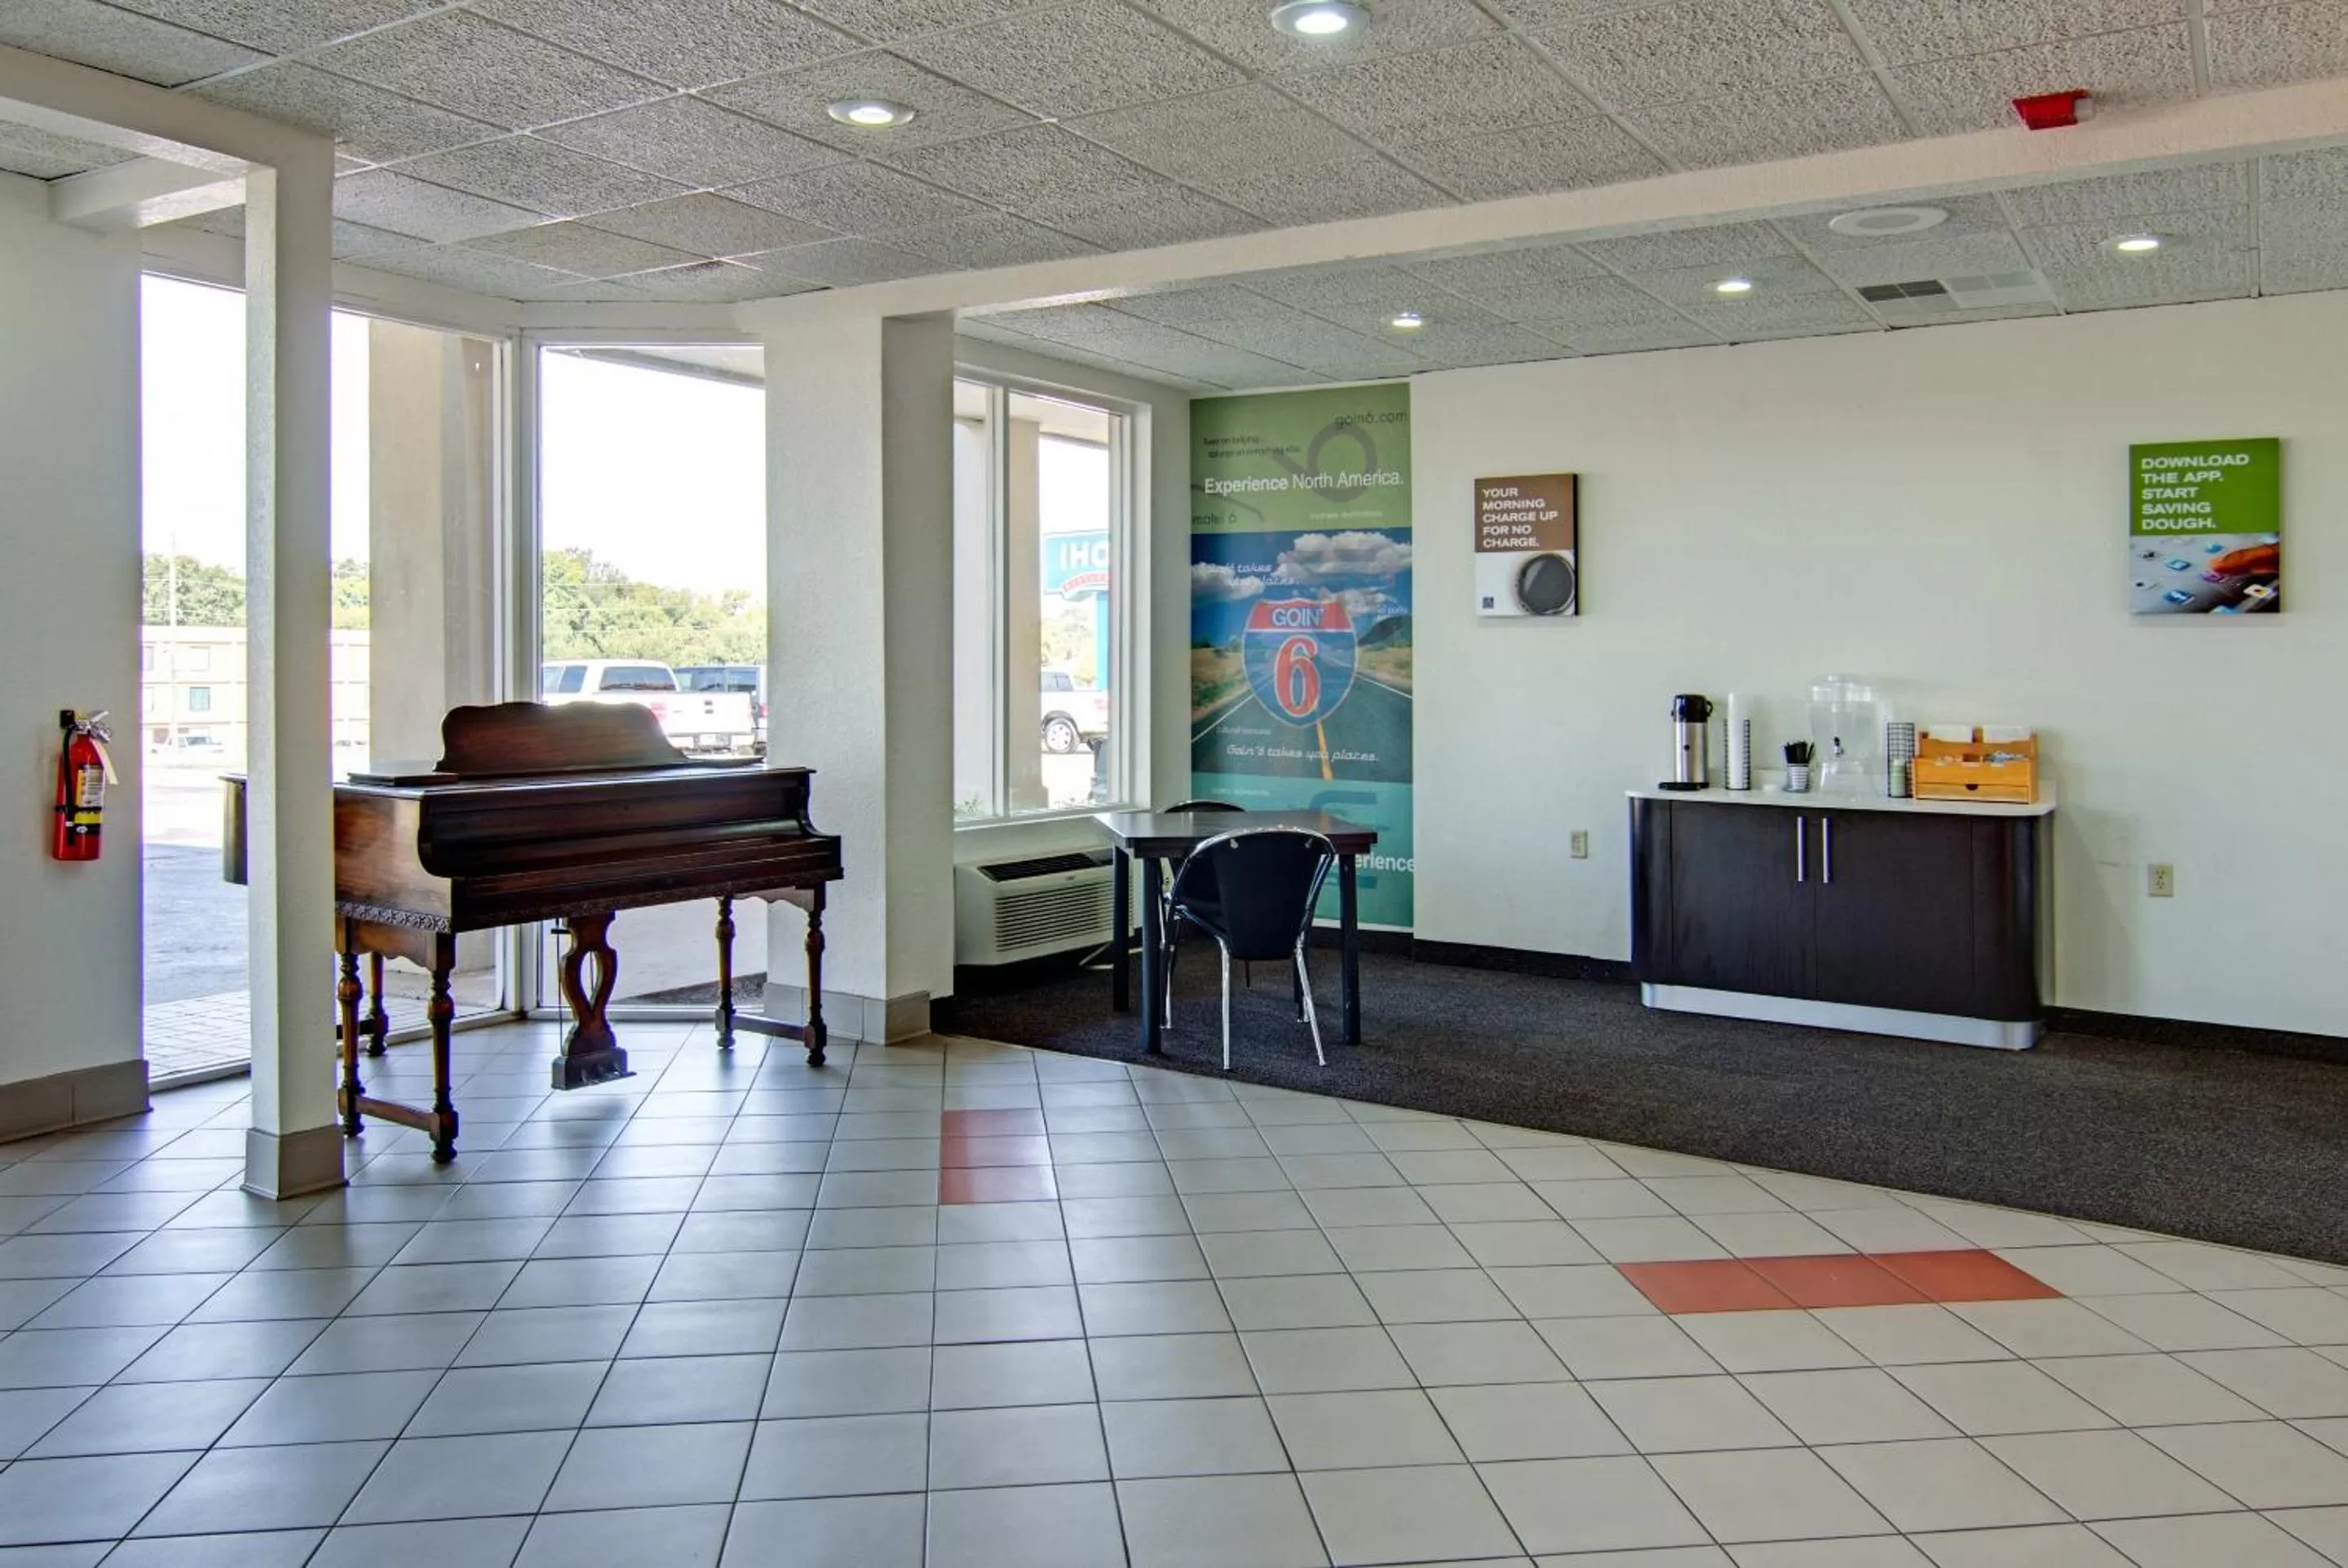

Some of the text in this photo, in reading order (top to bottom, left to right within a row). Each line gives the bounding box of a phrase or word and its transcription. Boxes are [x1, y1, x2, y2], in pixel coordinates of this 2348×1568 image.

[2141, 453, 2250, 470] DOWNLOAD
[1204, 470, 1404, 497] Experience North America.
[2141, 470, 2224, 484] THE APP.
[1482, 487, 1519, 498] YOUR
[2141, 487, 2200, 500] START
[1482, 498, 1545, 510] MORNING
[2141, 501, 2213, 515] SAVING
[1482, 510, 1559, 523] CHARGE UP
[1483, 524, 1532, 537] FOR NO
[2141, 518, 2218, 531] DOUGH.
[1483, 537, 1540, 549] CHARGE.
[1059, 541, 1109, 572] IHO
[1271, 607, 1325, 627] GOIN'
[1273, 634, 1321, 718] 6
[1333, 850, 1417, 872] erience
